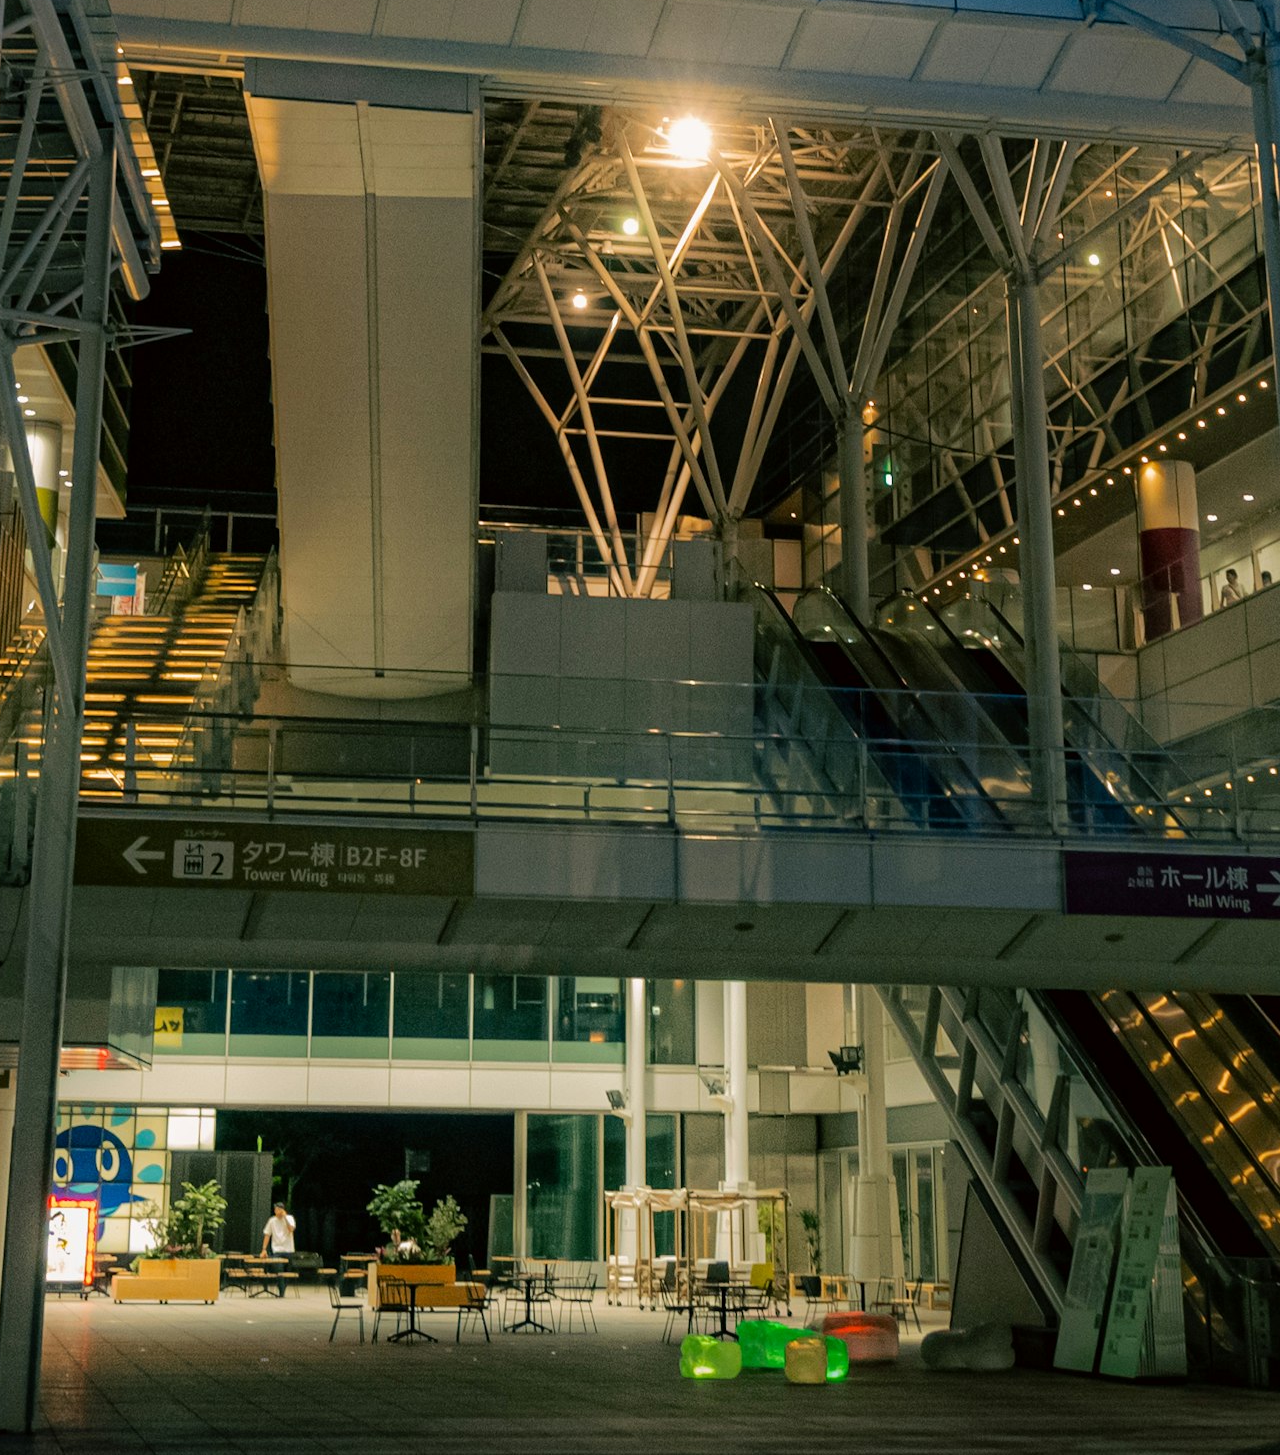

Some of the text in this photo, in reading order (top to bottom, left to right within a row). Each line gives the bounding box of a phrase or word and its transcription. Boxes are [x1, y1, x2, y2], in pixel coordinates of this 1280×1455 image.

[210, 852, 224, 877] 2
[242, 841, 427, 869] タワー棟 B2F-8F
[242, 866, 328, 887] Tower Wing
[1160, 865, 1249, 890] ホール棟
[1187, 893, 1251, 913] Hall Wing
